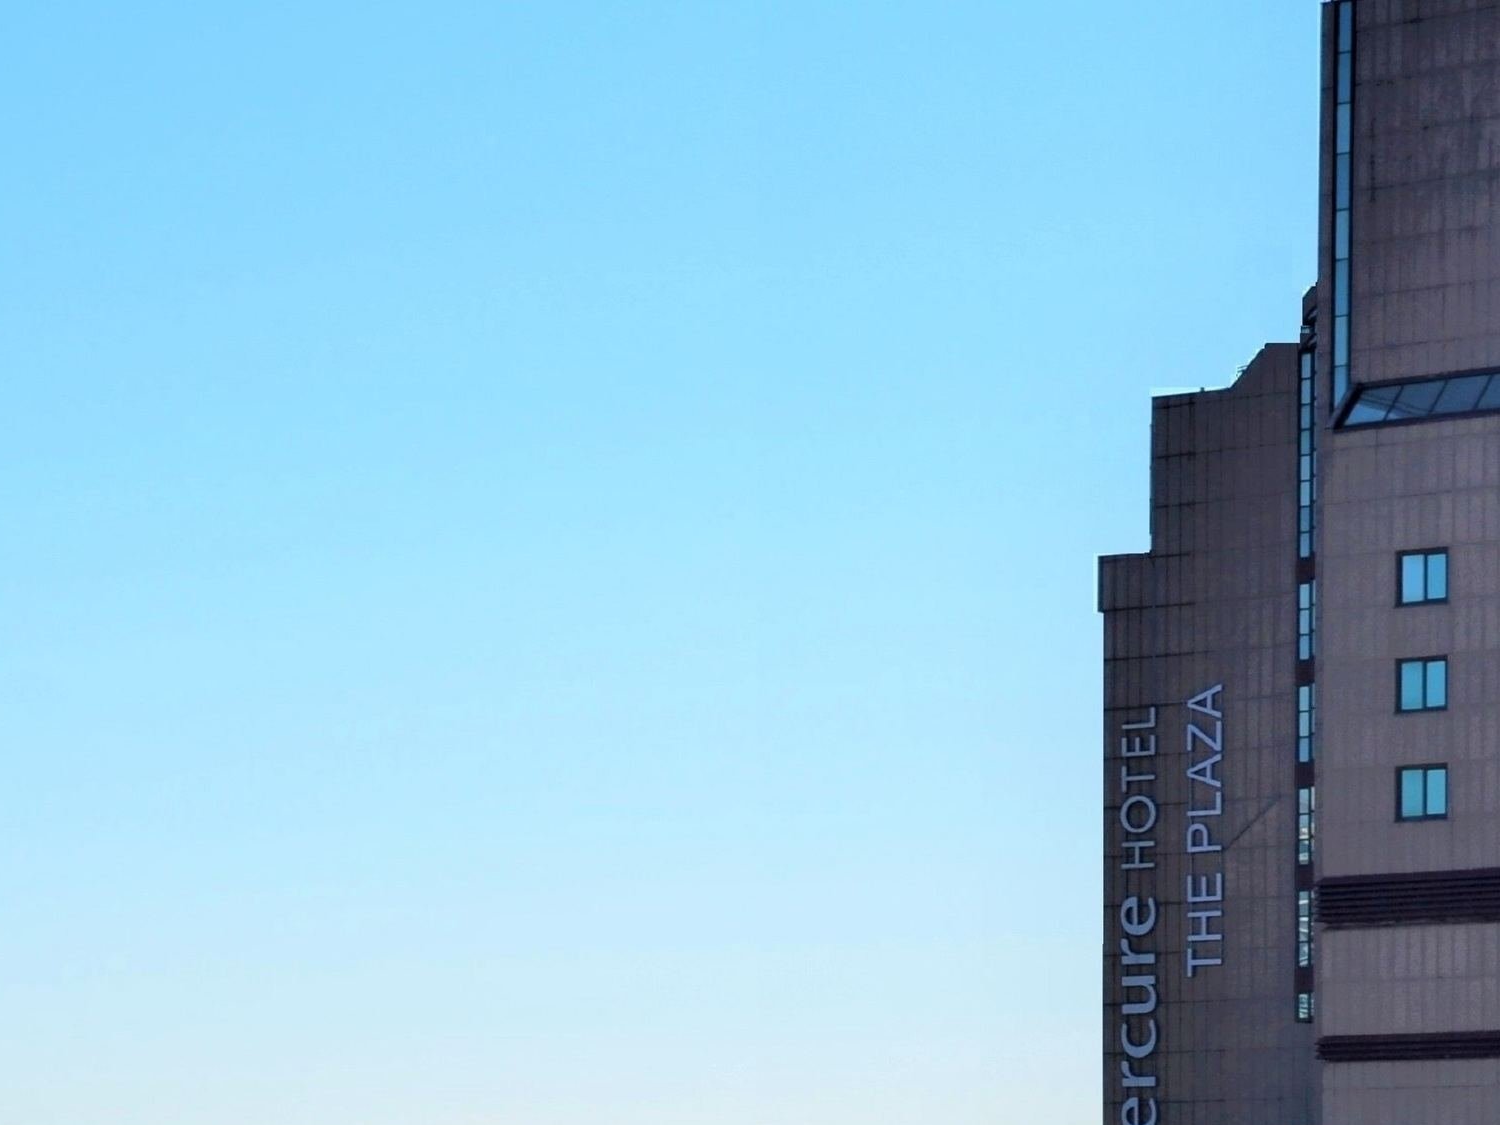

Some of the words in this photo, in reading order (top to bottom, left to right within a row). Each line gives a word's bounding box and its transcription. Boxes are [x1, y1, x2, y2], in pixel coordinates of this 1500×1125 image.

[1120, 706, 1157, 870] HOTEL
[1186, 683, 1223, 854] PLAZA
[1186, 872, 1223, 978] THE
